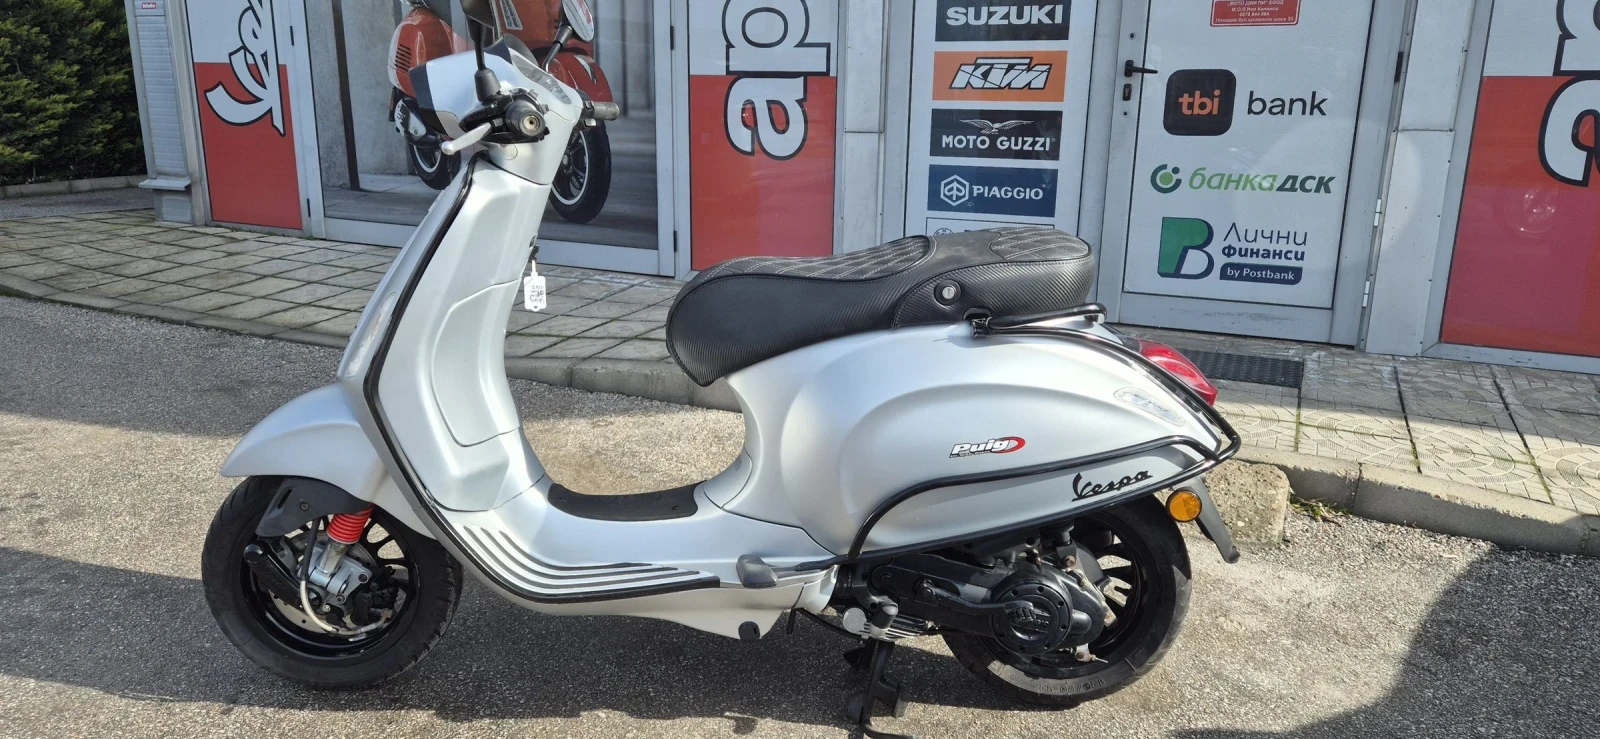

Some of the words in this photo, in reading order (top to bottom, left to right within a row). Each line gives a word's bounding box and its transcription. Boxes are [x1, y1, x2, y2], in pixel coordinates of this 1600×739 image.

[946, 4, 1064, 26] SUZUKI
[949, 56, 1053, 90] KTM
[1178, 89, 1221, 116] tbi
[1247, 90, 1329, 117] bank
[942, 134, 991, 149] MOTO
[996, 136, 1050, 151] GUZZI
[972, 185, 1044, 200] PIAGGIO
[1223, 222, 1308, 246] Лични
[1221, 244, 1306, 262] Финанси
[1226, 267, 1241, 279] by
[1242, 267, 1296, 281] Postbank
[950, 438, 1011, 455] Puig
[1071, 470, 1154, 502] Vespa
